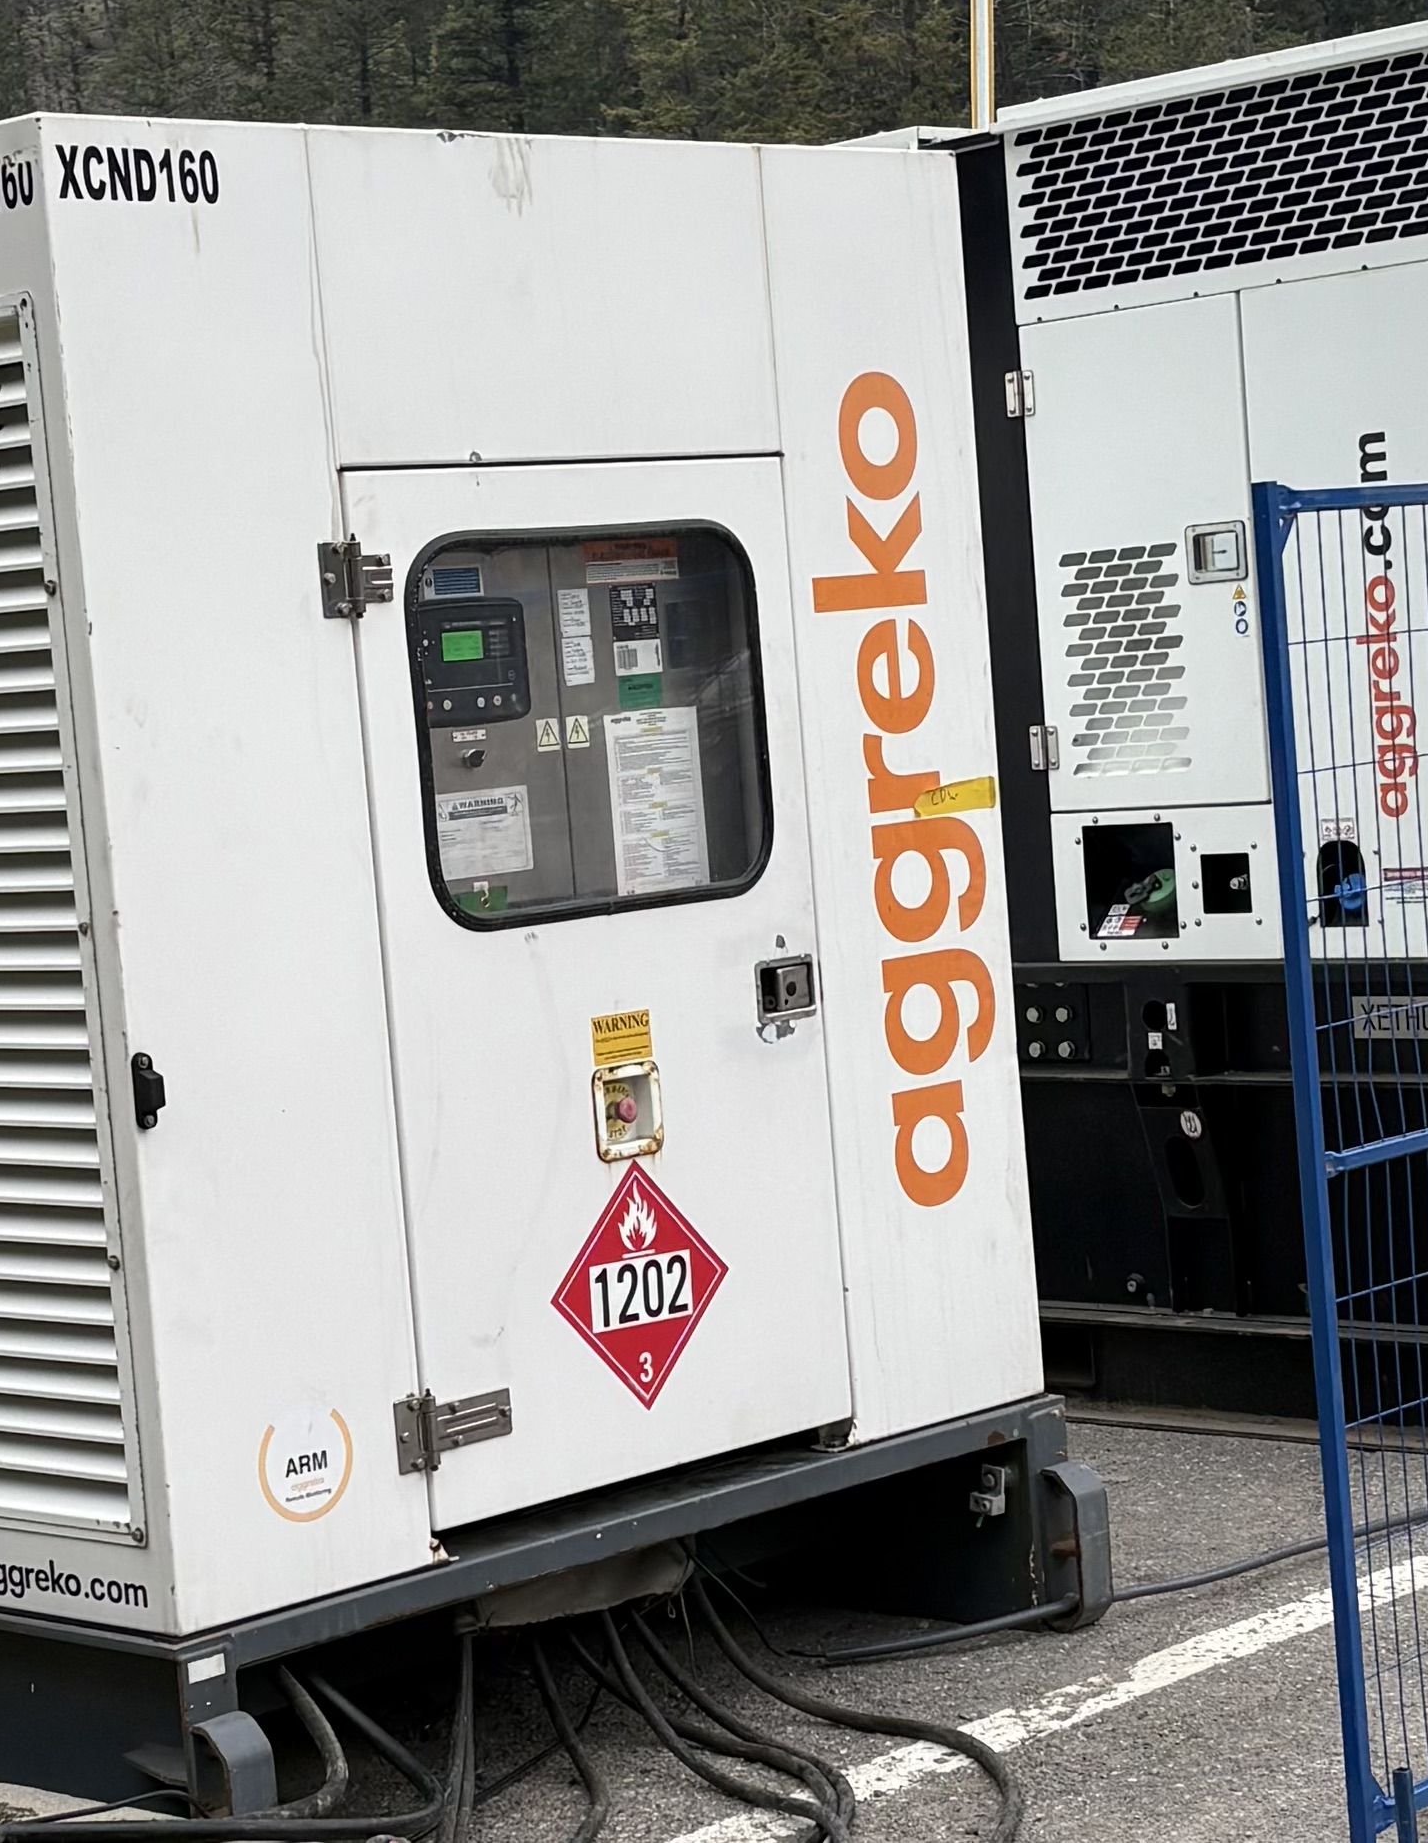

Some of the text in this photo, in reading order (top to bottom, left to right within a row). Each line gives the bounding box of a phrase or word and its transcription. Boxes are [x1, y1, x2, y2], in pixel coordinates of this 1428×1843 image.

[56, 144, 220, 204] XCND160
[812, 371, 995, 1208] aggreko
[592, 1012, 650, 1034] WARNING
[594, 1254, 689, 1328] 1202
[638, 1351, 654, 1383] 3
[285, 1449, 328, 1478] ARM
